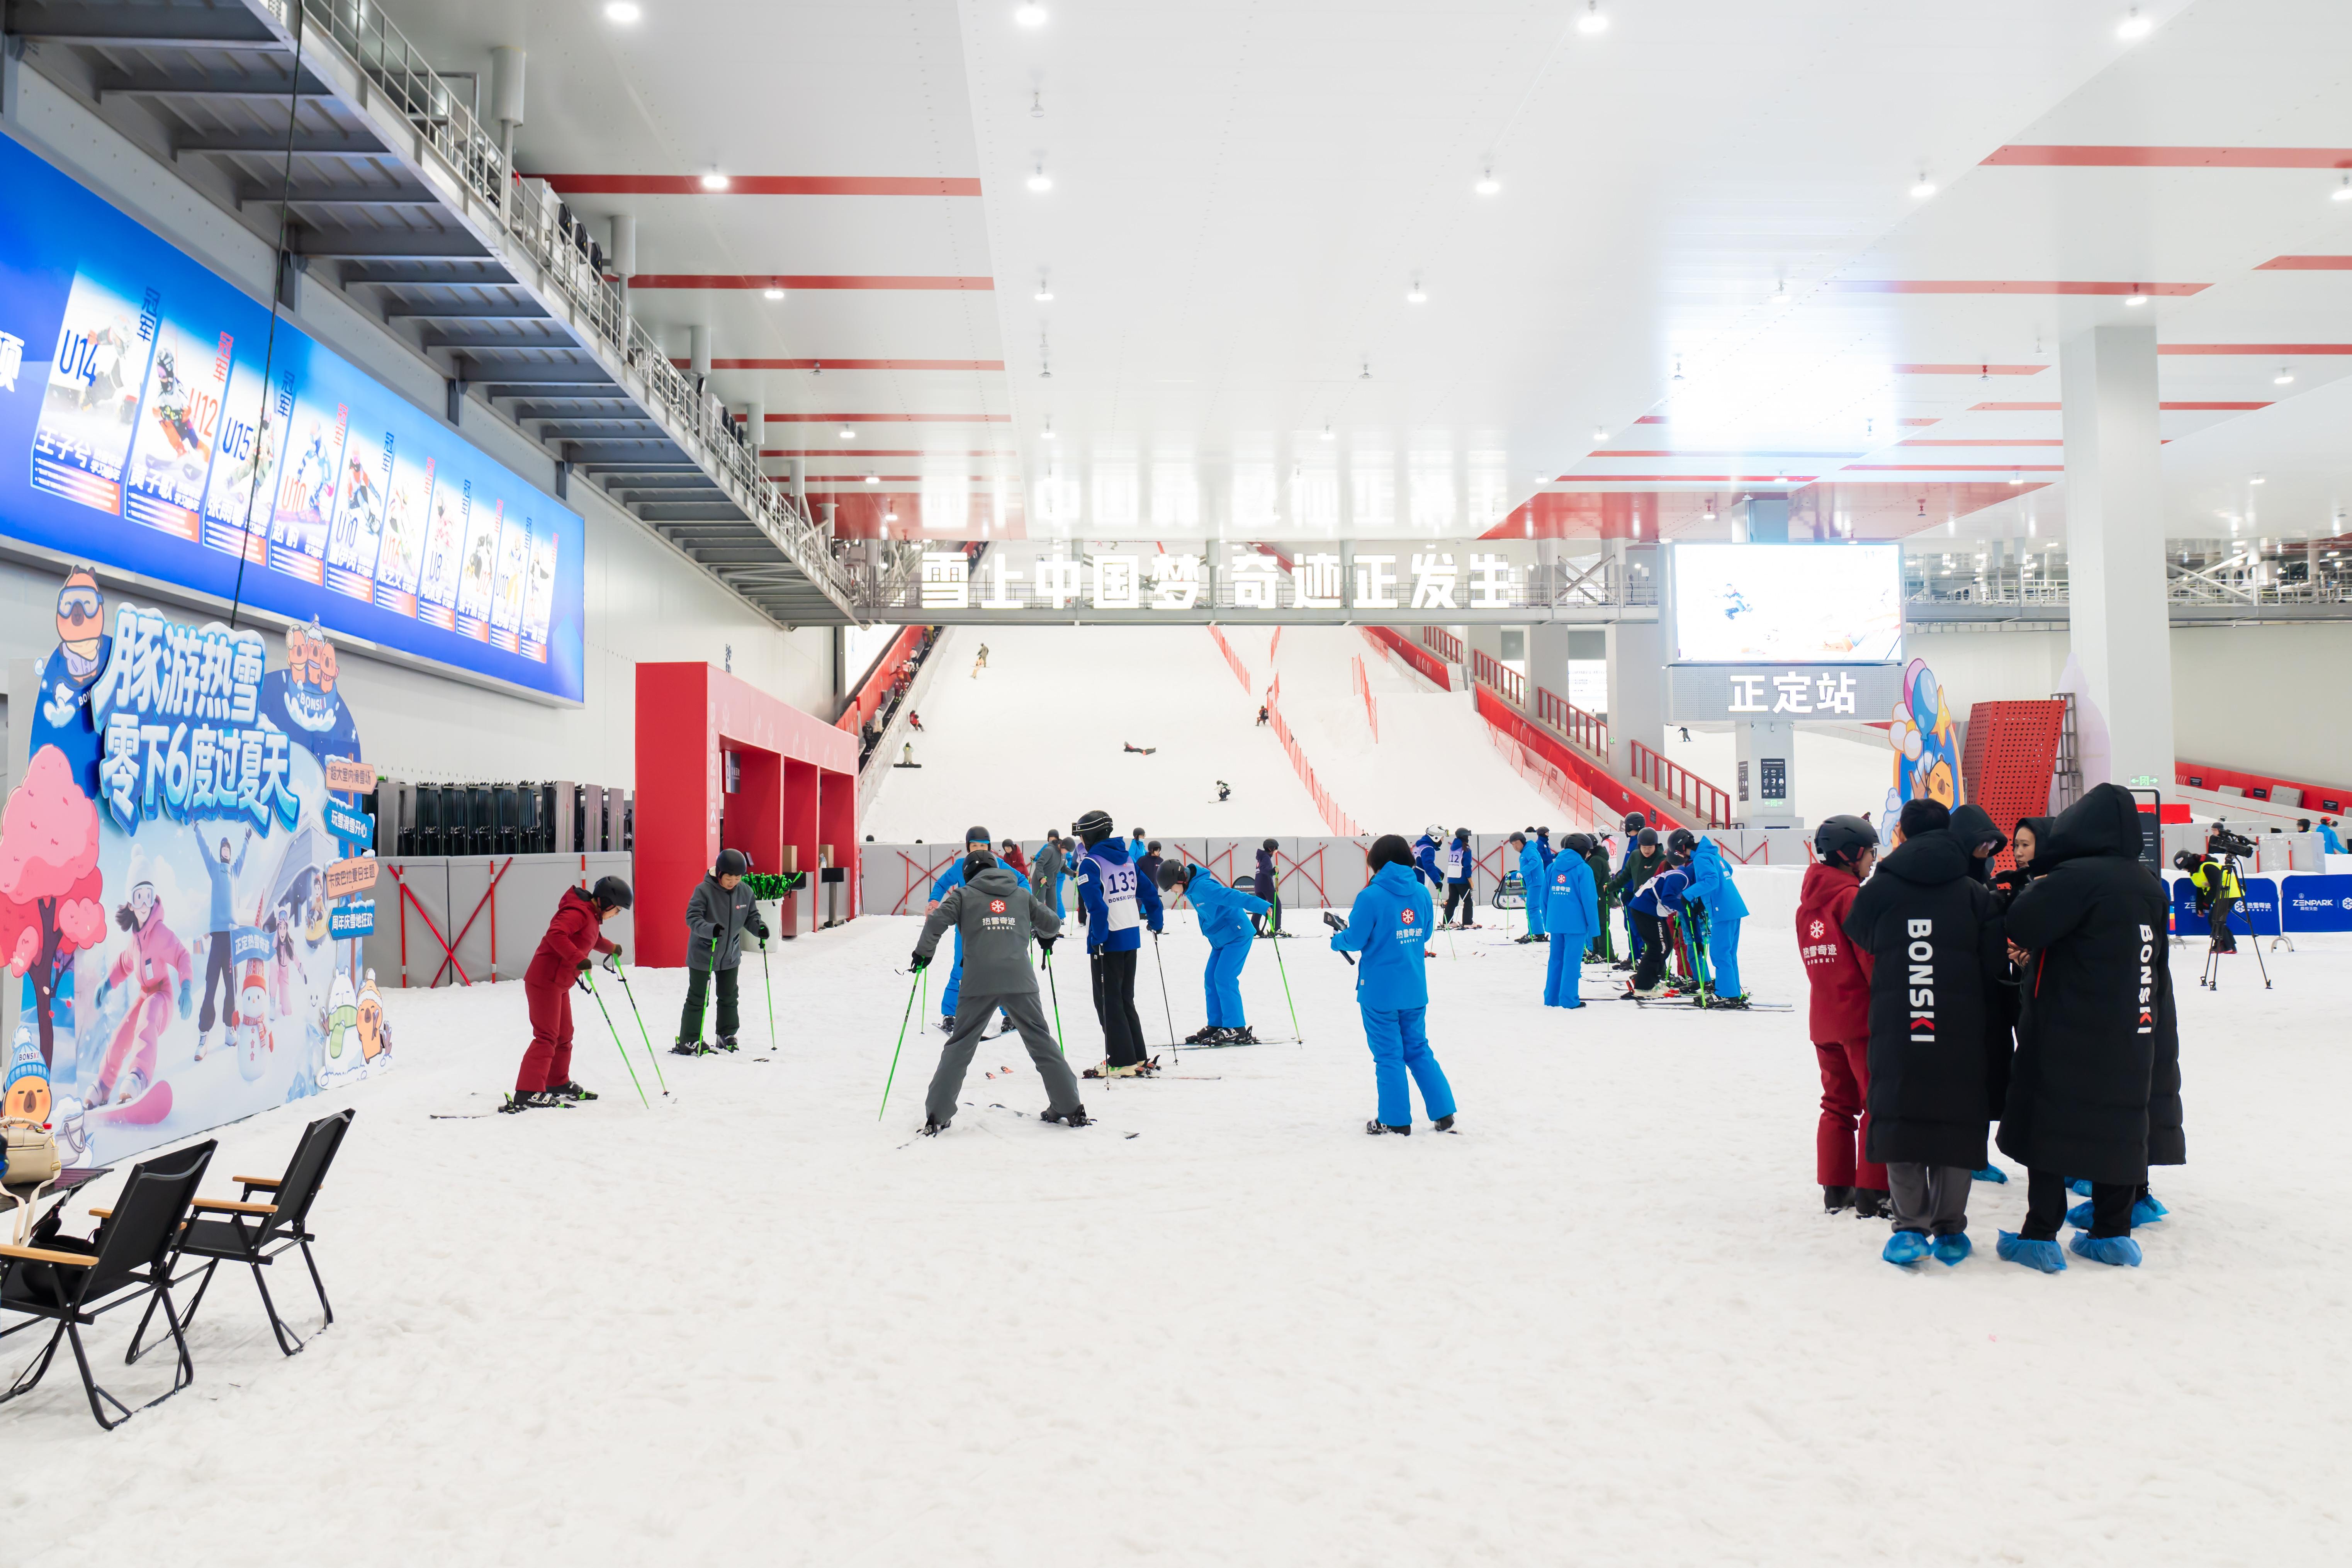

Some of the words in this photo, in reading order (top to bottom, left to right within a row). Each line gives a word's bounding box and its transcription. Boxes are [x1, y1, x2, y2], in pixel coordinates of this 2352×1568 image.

[137, 287, 161, 342] 冠军
[59, 330, 98, 386] U14
[214, 331, 234, 382] 冠军
[189, 388, 217, 438] U12
[278, 370, 294, 417] 冠军
[222, 417, 253, 461] U15
[334, 403, 348, 447] 冠军
[382, 432, 394, 472] 冠军
[282, 476, 306, 512] U10
[430, 550, 442, 581] U8
[922, 552, 1200, 609] 雪上中国梦
[1231, 553, 1509, 609] 奇迹正发生
[94, 612, 263, 724] 豚游热雪
[300, 692, 326, 711] BONSKI
[1728, 671, 1856, 713] 正定站
[103, 715, 298, 826] 零下6度过夏天
[331, 766, 371, 785] 超大室内滑雪场
[331, 809, 367, 838] 玩雪滑雪开心
[329, 864, 375, 888] 卡皮巴拉夏日主题
[1108, 871, 1135, 894] 133
[332, 913, 373, 930] 周年庆雪地狂欢
[982, 917, 1016, 926] 热雪奇迹
[1396, 928, 1422, 939] 热雪奇迹
[235, 934, 270, 955] 正定热雪奇迹
[1803, 944, 1837, 958] 热雪奇迹
[1908, 919, 1935, 1042] BONSKI
[2137, 924, 2153, 1034] BONSKI
[19, 1052, 39, 1061] BONSKI
